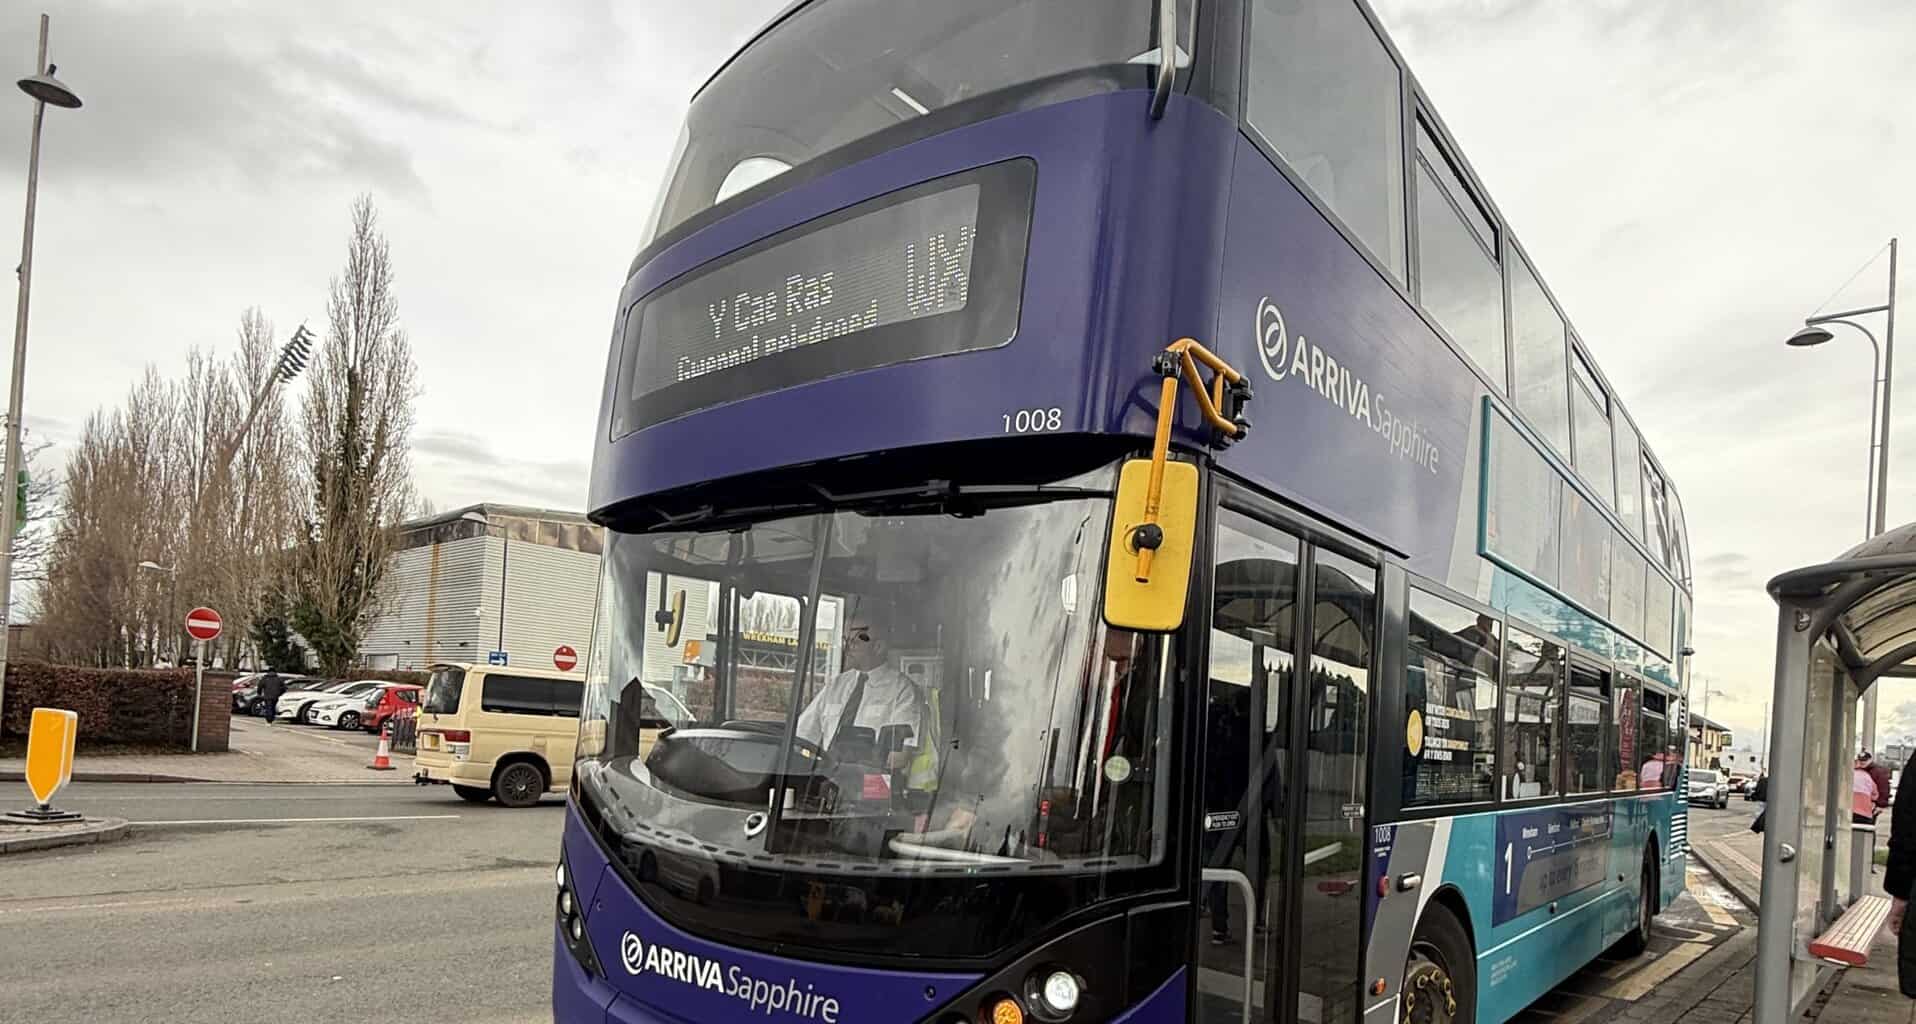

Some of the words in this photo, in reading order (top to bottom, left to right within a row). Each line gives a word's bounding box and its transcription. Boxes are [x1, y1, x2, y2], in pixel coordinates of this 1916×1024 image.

[709, 299, 727, 339] Y
[734, 291, 777, 331] Cae
[786, 271, 834, 317] Ras
[1002, 407, 1062, 433] 1008
[1290, 335, 1372, 429] ARRIVA
[1372, 393, 1440, 475] Sapphire
[1374, 826, 1391, 843] 1008
[1504, 841, 1513, 895] 1
[644, 944, 725, 993] ARRIVA
[725, 965, 840, 1024] Sapphire
